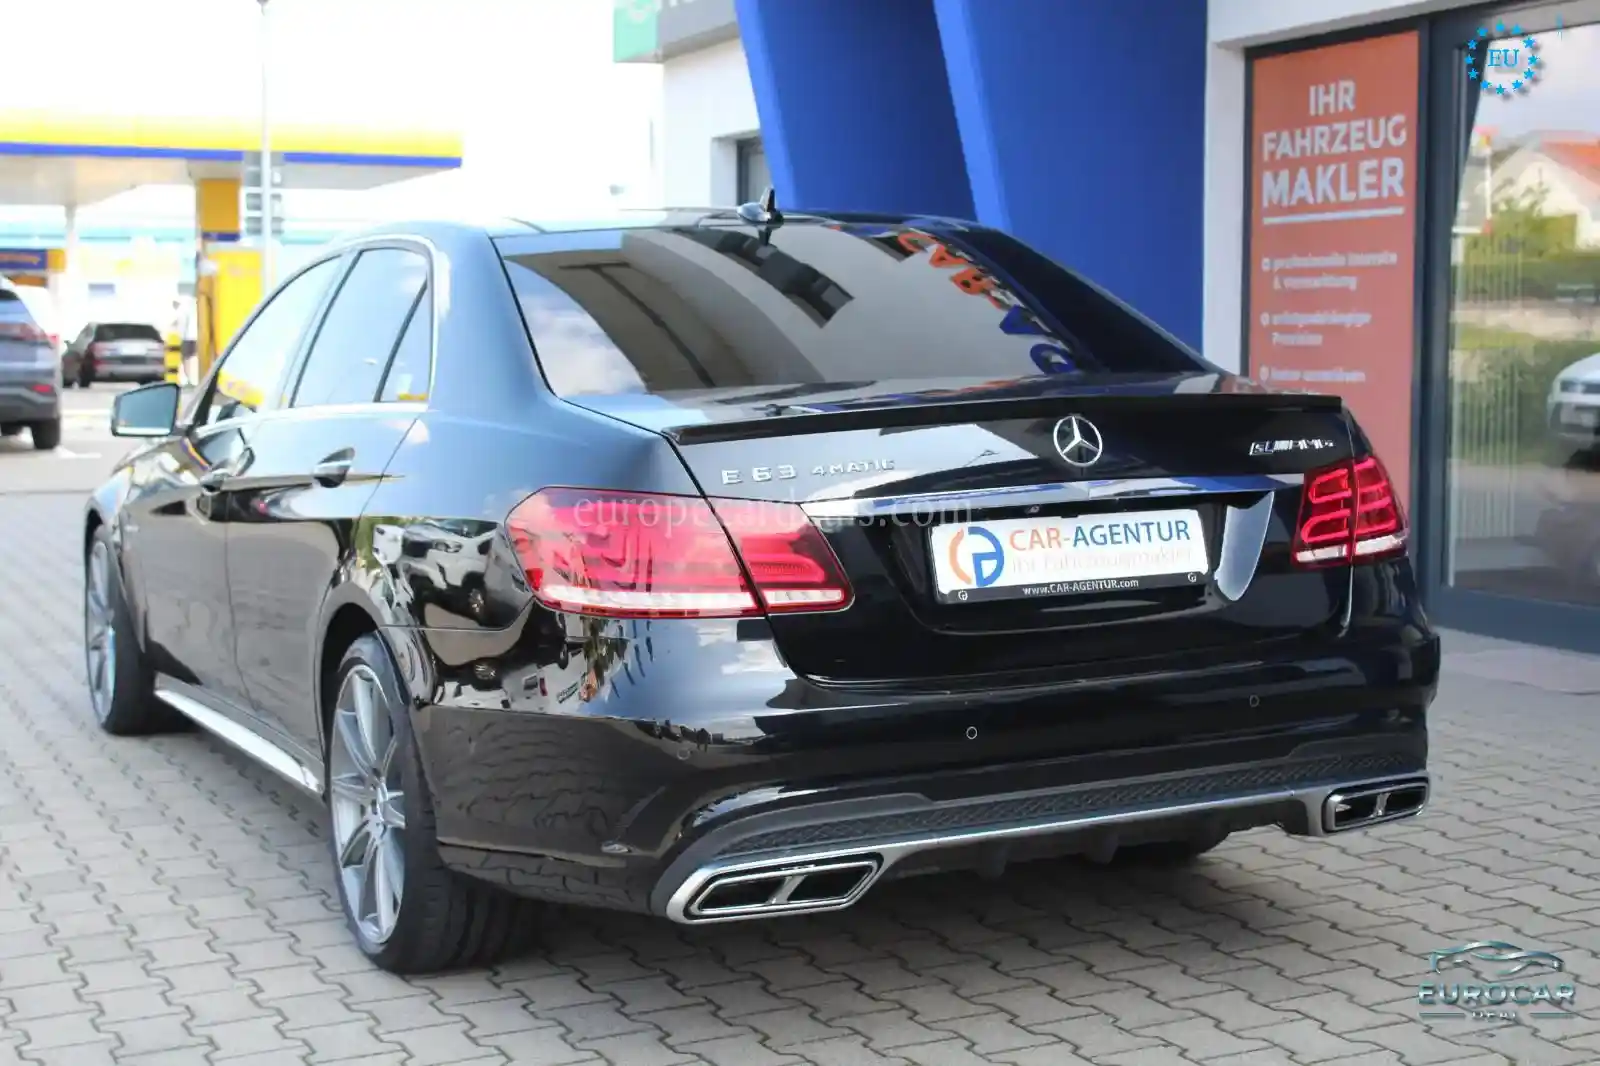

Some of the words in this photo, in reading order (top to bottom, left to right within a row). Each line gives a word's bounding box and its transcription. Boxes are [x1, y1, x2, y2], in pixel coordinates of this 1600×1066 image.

[1309, 79, 1356, 117] IHR
[1262, 114, 1407, 162] FAHRZEUG
[1262, 157, 1405, 208] MAKLER
[721, 469, 742, 485] E
[752, 464, 797, 482] 63
[811, 458, 896, 477] 4MATIC
[1010, 520, 1190, 551] CAR-AGENTUR
[1022, 578, 1139, 596] www.CAR-AGENTUR.com
